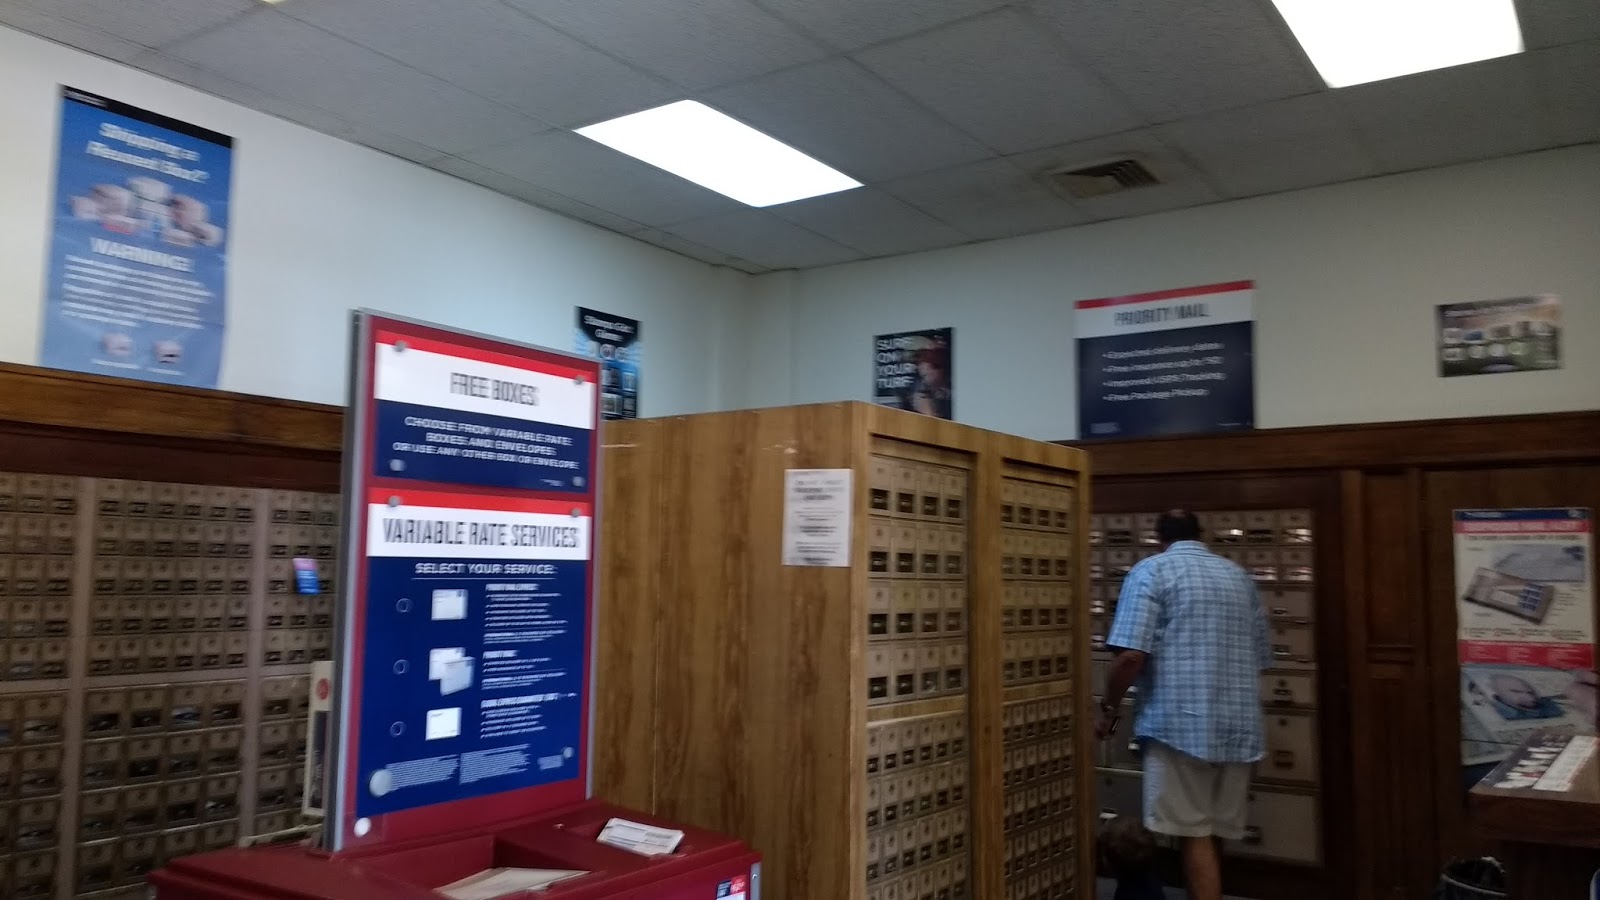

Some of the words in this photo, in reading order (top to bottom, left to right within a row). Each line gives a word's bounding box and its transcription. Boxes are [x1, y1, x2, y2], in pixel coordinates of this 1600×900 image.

[1113, 307, 1170, 326] PRIORITY
[1174, 303, 1209, 319] MAIL
[876, 351, 896, 364] ON
[876, 362, 917, 376] YOUR
[449, 372, 490, 398] FREE
[491, 378, 538, 406] BOXES
[876, 376, 915, 389] TURF
[404, 416, 458, 431] CHOOSE
[458, 423, 493, 435] FROM
[493, 427, 544, 442] VARIABLE
[543, 434, 573, 446] RATE
[425, 432, 469, 445] BOXES
[468, 437, 495, 448] AND
[495, 440, 557, 455] ENVELOPES
[392, 441, 412, 452] OR
[412, 443, 437, 454] USE
[436, 446, 461, 456] ANY
[461, 448, 497, 460] OTHER
[496, 452, 518, 462] BOX
[517, 455, 534, 464] OR
[532, 457, 580, 470] ENVELOPE
[383, 517, 465, 544] VARIABLE
[468, 521, 509, 546] RATE
[510, 523, 580, 548] SERVICES
[414, 562, 466, 574] SELECT
[467, 564, 504, 575] YOUR
